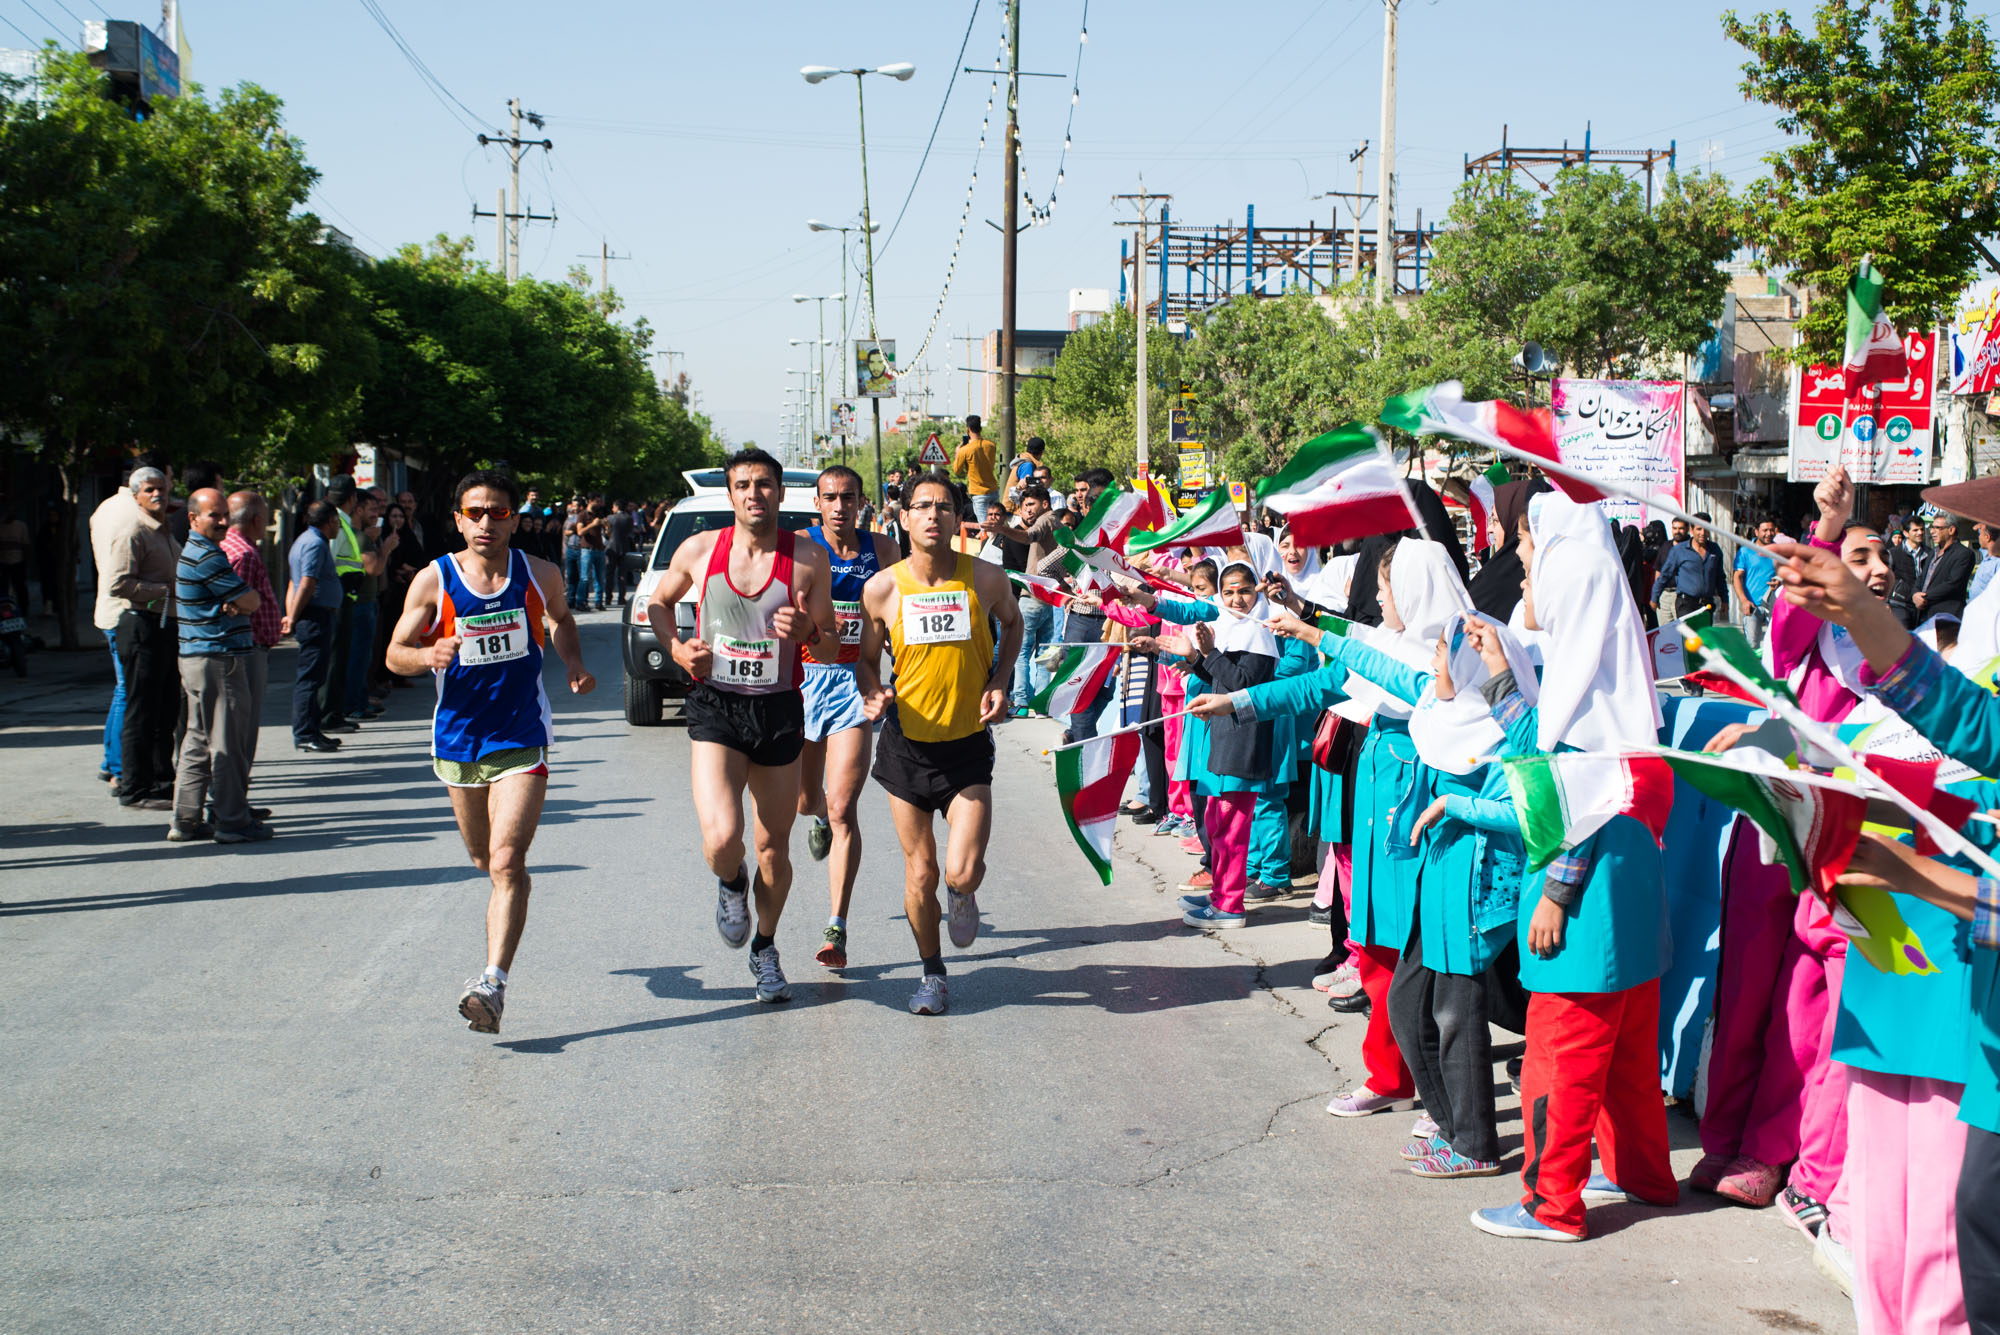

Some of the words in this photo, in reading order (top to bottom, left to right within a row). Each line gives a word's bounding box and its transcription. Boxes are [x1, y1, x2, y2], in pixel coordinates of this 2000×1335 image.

[1807, 373, 1846, 398] صر
[1578, 394, 1631, 431] جوانان
[1606, 404, 1679, 441] اعتکاف
[831, 564, 865, 574] aucony
[920, 614, 955, 633] 182
[476, 633, 511, 655] 181
[493, 650, 524, 661] Marathon
[728, 659, 763, 677] 163
[727, 675, 740, 683] Iran
[741, 676, 772, 684] Marathon
